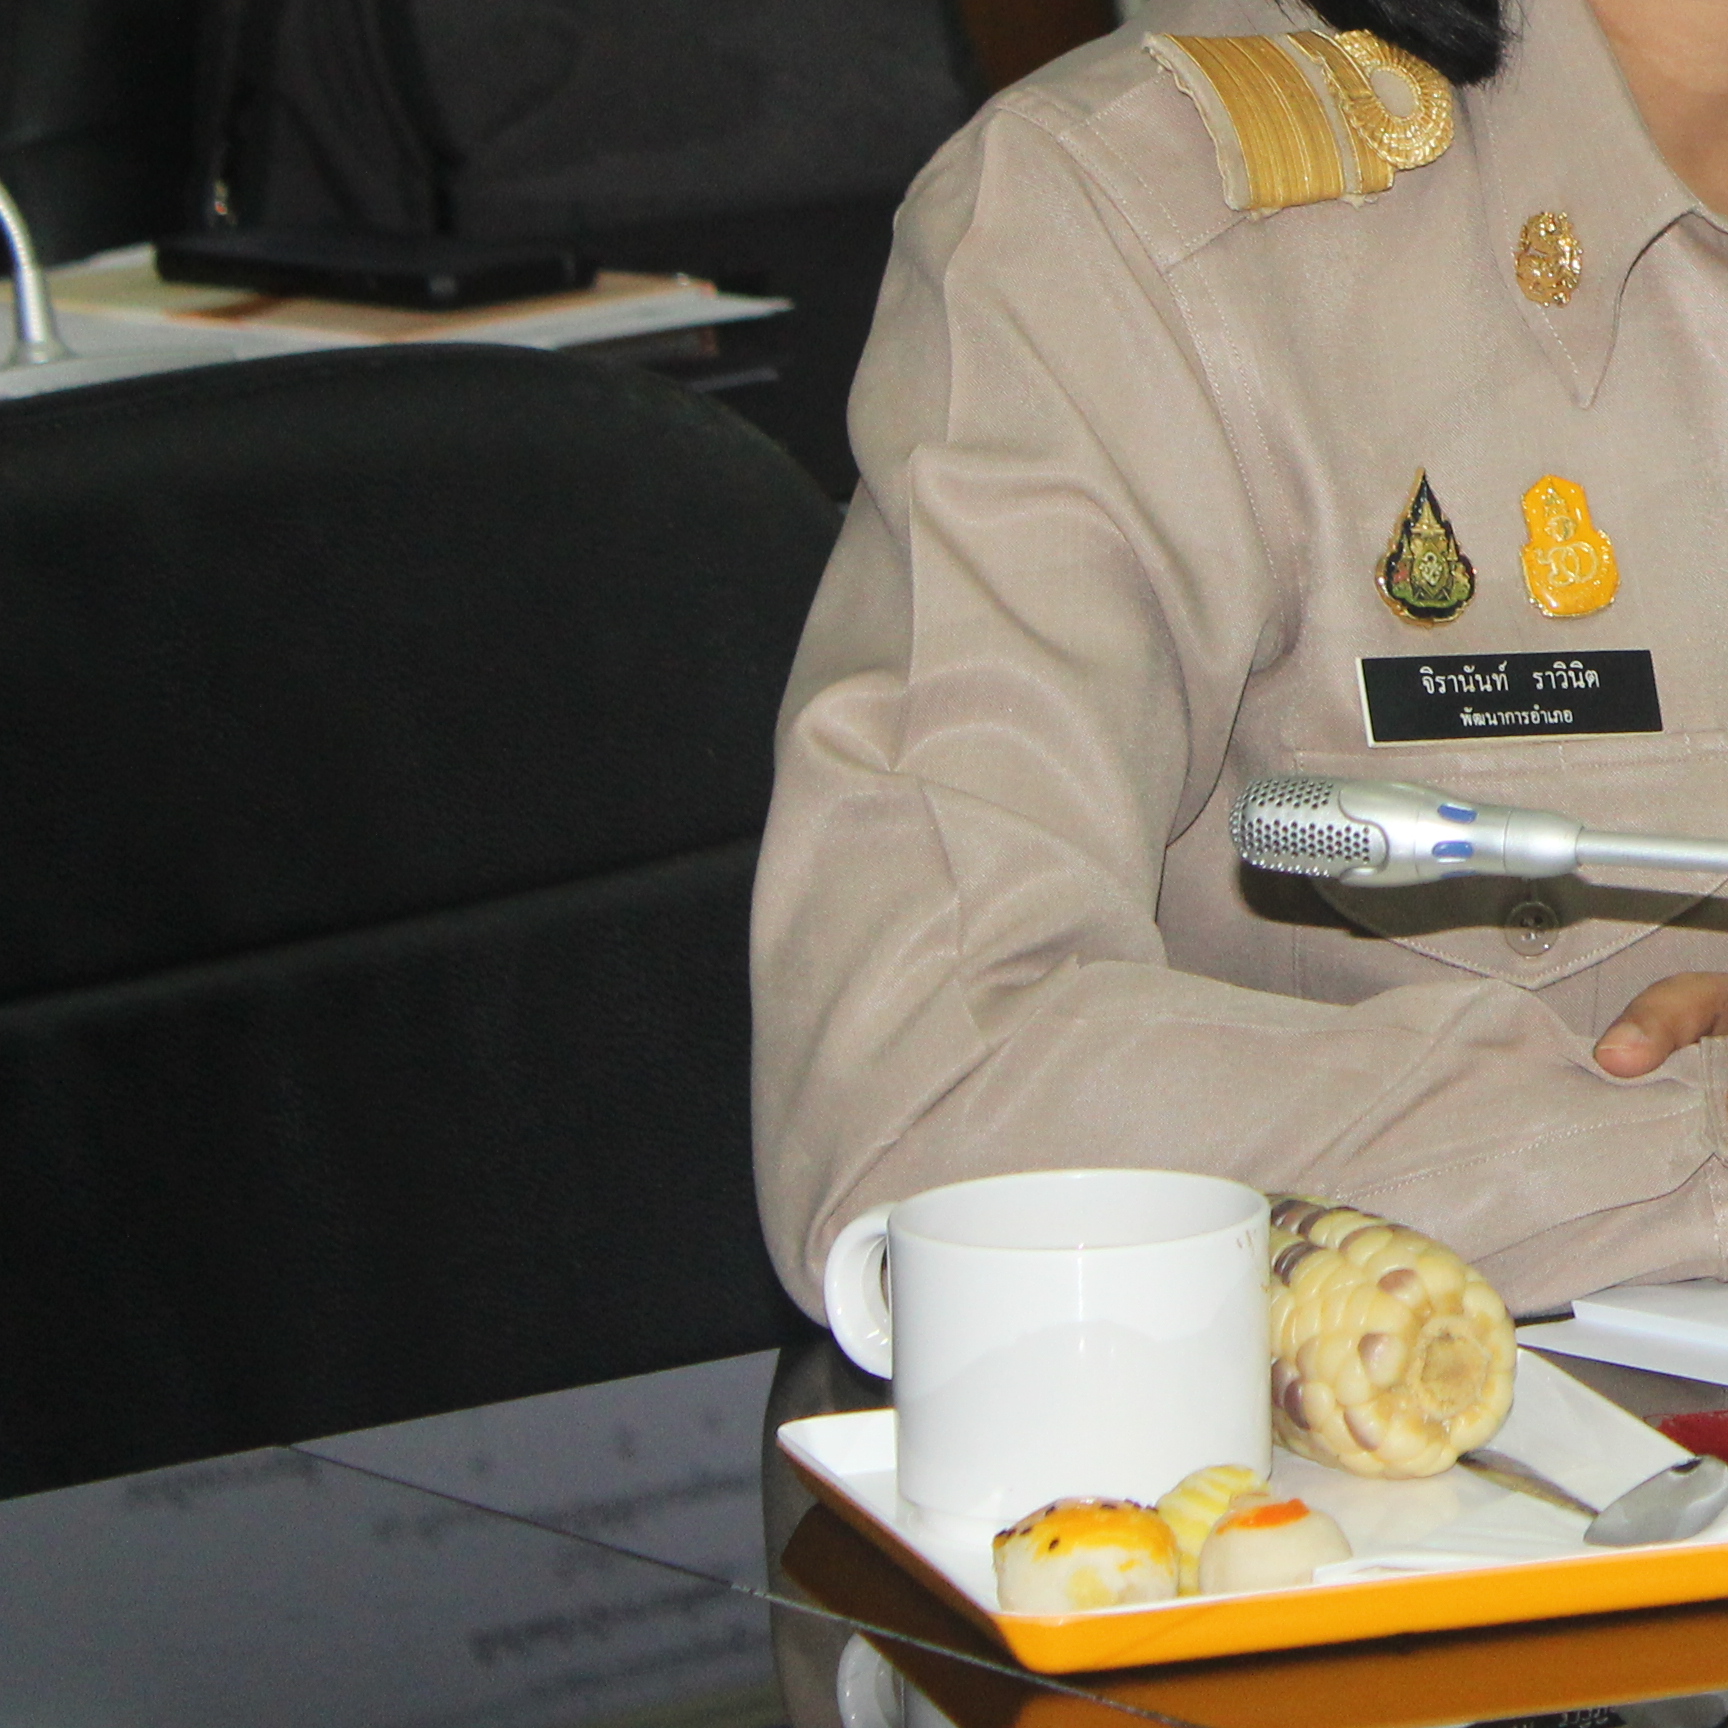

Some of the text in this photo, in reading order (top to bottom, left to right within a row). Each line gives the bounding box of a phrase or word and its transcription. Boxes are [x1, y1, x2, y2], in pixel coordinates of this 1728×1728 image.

[1419, 659, 1600, 695] จิรานันท์ ราวินิต
[1459, 703, 1574, 728] พัฒนาการอำเภอ
